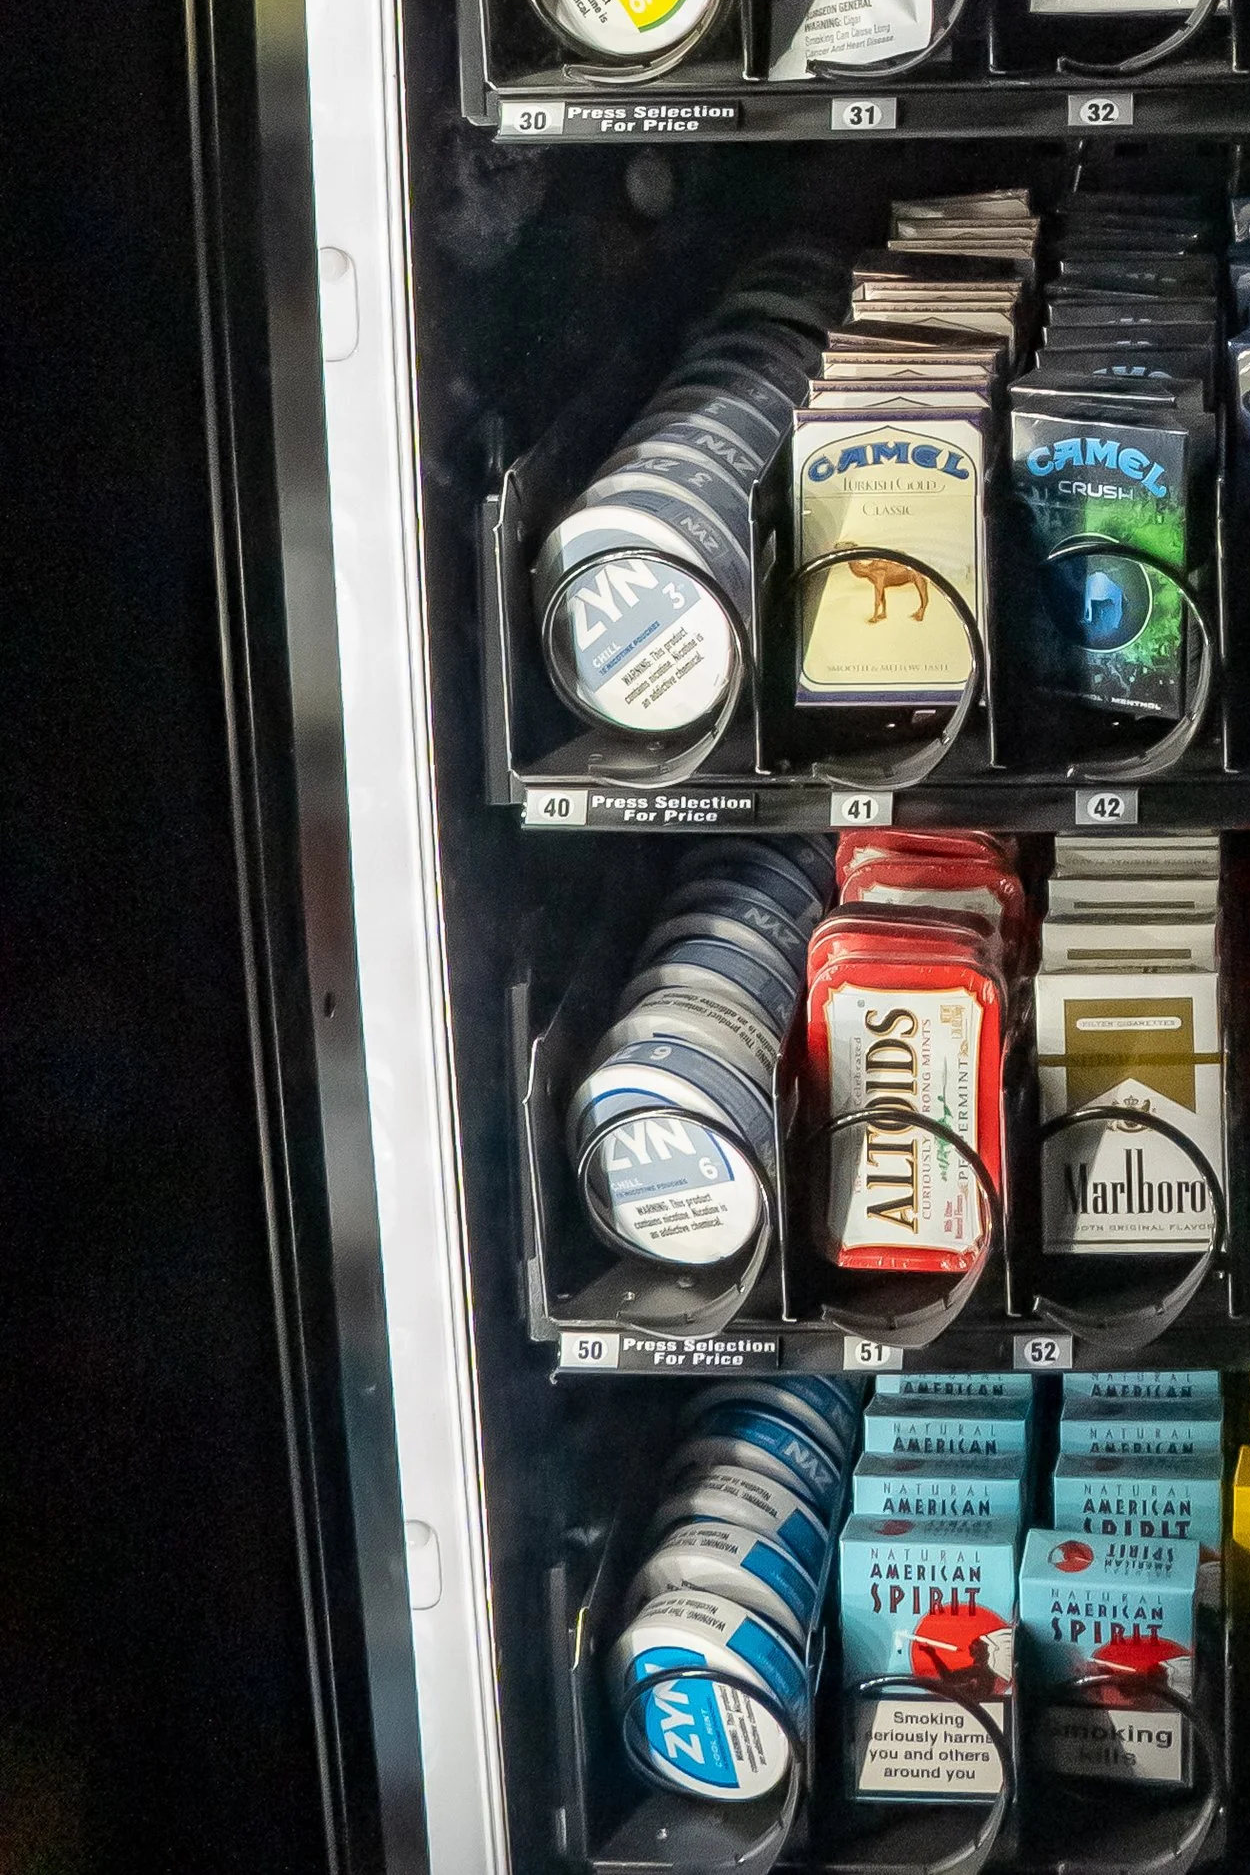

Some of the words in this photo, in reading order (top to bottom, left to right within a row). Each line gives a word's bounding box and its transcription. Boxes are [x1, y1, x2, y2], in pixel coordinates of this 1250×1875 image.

[843, 15, 861, 26] Cigar
[805, 32, 835, 47] Smoking
[836, 29, 850, 41] Can
[851, 27, 872, 38] Cause
[846, 40, 865, 50] Heart
[519, 111, 546, 130] 30
[567, 106, 627, 120] Press
[634, 106, 735, 119] Selection
[849, 105, 875, 125] 31
[1085, 101, 1115, 123] 32
[601, 119, 636, 132] For
[645, 118, 699, 132] Price
[807, 441, 970, 483] CAMEL
[1026, 438, 1167, 498] CAMEL
[1058, 480, 1133, 501] CRUSH
[662, 582, 686, 610] 3
[592, 641, 622, 669] CHILL
[650, 644, 665, 664] This
[663, 627, 688, 653] product
[543, 798, 569, 819] 40
[591, 795, 652, 809] Press
[655, 795, 751, 809] Selection
[623, 809, 657, 823] For
[664, 809, 718, 824] Price
[848, 798, 872, 819] 41
[1093, 797, 1120, 818] 42
[921, 1018, 932, 1068] MINTS
[864, 1007, 919, 1235] ALTOIDS
[699, 1157, 718, 1180] 6
[1064, 1149, 1207, 1215] Marlboro
[577, 1340, 603, 1360] 50
[622, 1339, 677, 1353] Press
[684, 1339, 775, 1352] Selection
[653, 1352, 685, 1365] For
[693, 1352, 743, 1366] Price
[860, 1342, 884, 1361] 51
[1031, 1341, 1056, 1363] 52
[892, 1438, 997, 1455] AMERICAN
[883, 1483, 989, 1496] NATURAL
[1083, 1483, 1192, 1496] NATURAL
[883, 1498, 990, 1516] AMERICAN
[1083, 1499, 1192, 1516] AMERICAN
[871, 1547, 981, 1564] NATURAL
[870, 1564, 982, 1583] AMERICAN
[871, 1583, 981, 1616] SPIRIT
[1051, 1588, 1162, 1605] NATURAL
[1050, 1601, 1163, 1620] AMERICAN
[1050, 1620, 1163, 1646] SPIRIT
[893, 1711, 965, 1728] Smoking
[869, 1748, 898, 1762] you
[904, 1747, 934, 1761] and
[938, 1747, 990, 1762] others
[884, 1767, 941, 1779] around
[946, 1768, 976, 1781] you
